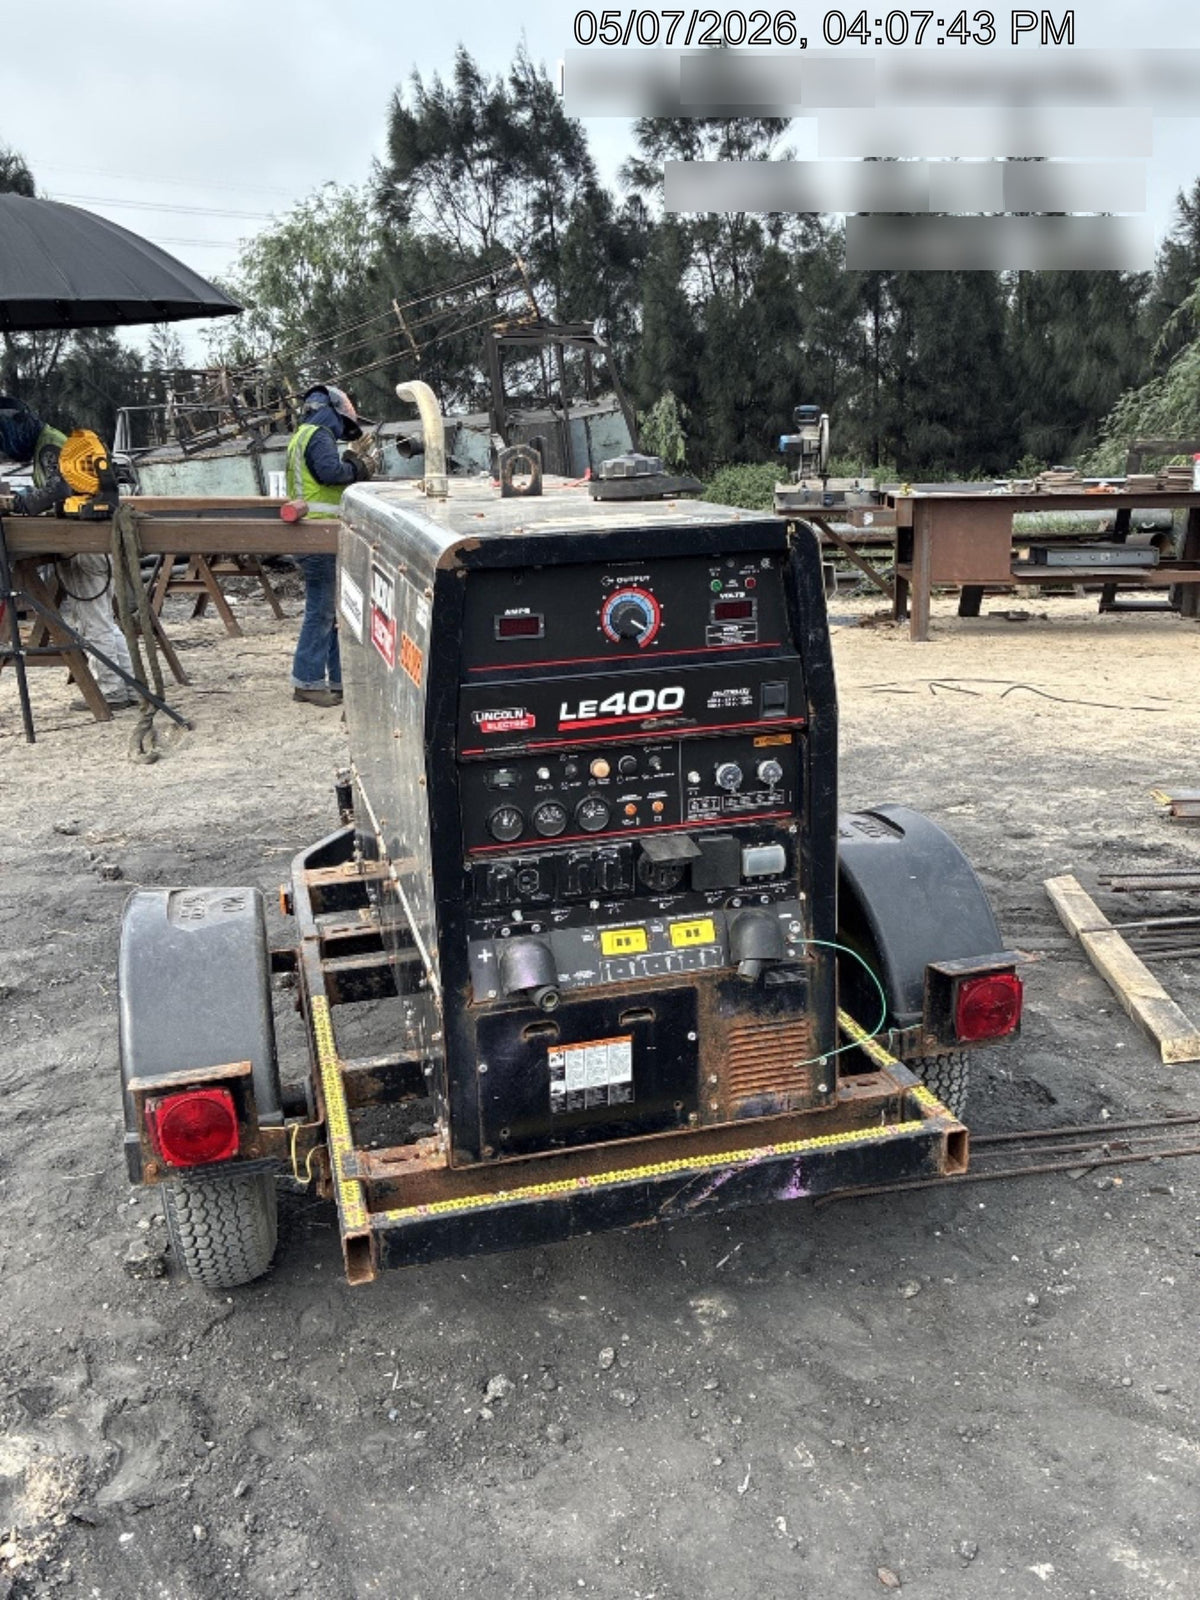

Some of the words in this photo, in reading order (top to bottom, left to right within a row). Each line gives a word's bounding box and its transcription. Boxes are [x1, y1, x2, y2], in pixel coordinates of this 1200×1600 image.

[719, 591, 746, 599] VOLTS
[504, 607, 531, 616] AMPS
[559, 686, 685, 721] LE400
[474, 708, 524, 722] LINCOLN
[486, 720, 530, 730] ELECTRIC
